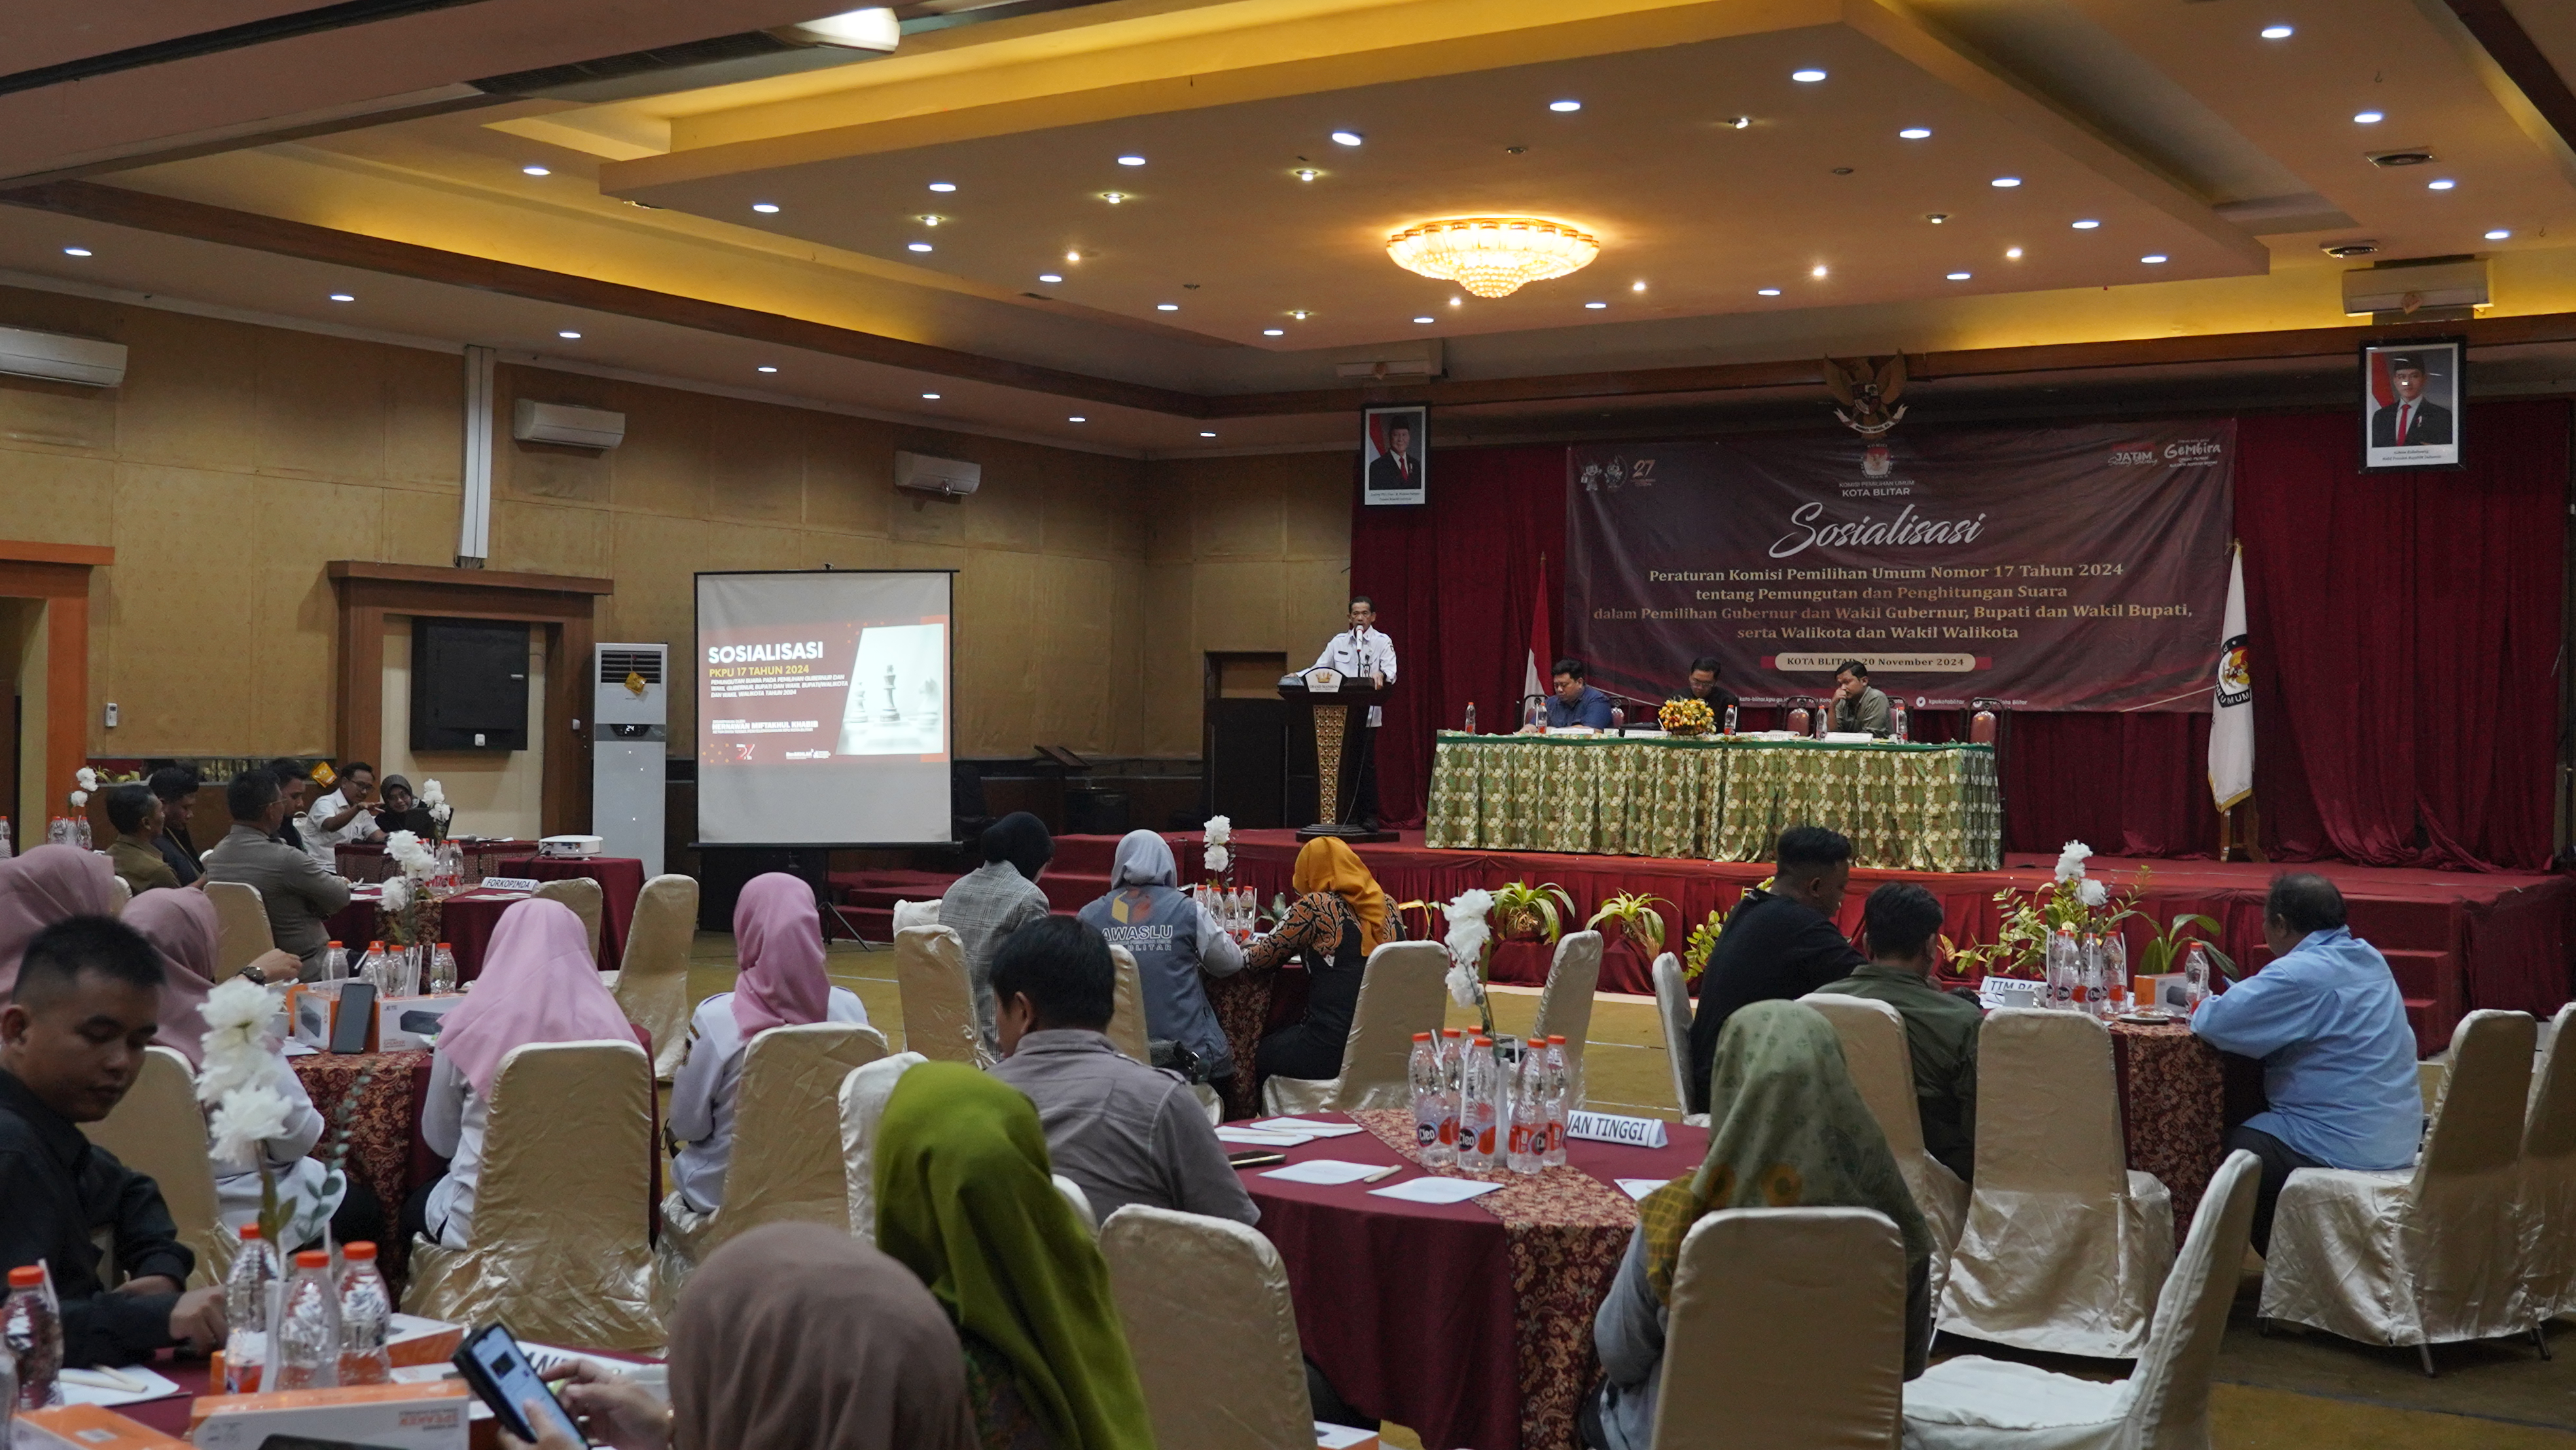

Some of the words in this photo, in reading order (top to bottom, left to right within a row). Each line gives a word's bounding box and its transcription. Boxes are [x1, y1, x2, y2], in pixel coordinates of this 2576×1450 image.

[2115, 451, 2153, 462] JATIM
[2164, 442, 2221, 459] Gembira
[1632, 459, 1656, 479] 27
[1842, 489, 1870, 497] KOTA
[1873, 487, 1910, 497] BLITAR
[1768, 501, 1987, 558] Sosialisasi
[1649, 569, 1725, 582] Peraturan
[1729, 569, 1783, 581] Komisi
[1787, 567, 1868, 580] Pemilihan
[1872, 567, 1926, 580] Umum
[1931, 567, 1989, 578] Nomor
[1994, 566, 2012, 578] 17
[2020, 565, 2073, 577] Tahun
[2079, 563, 2124, 576] 2024
[1696, 589, 1755, 603] tentang
[1759, 588, 1859, 602] Pemungutan
[1863, 588, 1893, 599] dan
[1897, 586, 2013, 601] Penghitungan
[2018, 585, 2068, 598] Suara
[1594, 608, 1637, 620] dalam
[1641, 607, 1717, 620] Pemilihan
[1722, 607, 1797, 620] Gubernur
[1801, 607, 1831, 619] dan
[1835, 606, 1881, 619] Wakil
[1885, 605, 1970, 620] Gubernur,
[1973, 605, 2030, 621] Bupati
[2035, 605, 2068, 618] dan
[2073, 604, 2123, 617] Wakil
[2128, 603, 2193, 619] Bupati,
[1737, 627, 1777, 639] serta
[1781, 626, 1851, 639] Walikota
[1855, 626, 1886, 639] dan
[1890, 626, 1938, 639] Wakil
[1943, 626, 2019, 639] Walikota
[708, 641, 823, 663] SOSIALISASI
[709, 667, 734, 677] PKPU
[737, 667, 746, 677] 17
[749, 666, 783, 676] TAHUN
[785, 665, 810, 675] 2024
[486, 878, 530, 889] FORKOPIMDA
[1101, 925, 1173, 942] AWASLU
[1127, 944, 1172, 952] BLITAR
[1991, 980, 2014, 991] TIM
[1418, 1127, 1435, 1141] Cleo
[1595, 1117, 1647, 1141] TINGGI
[1458, 1132, 1474, 1145] Cleo
